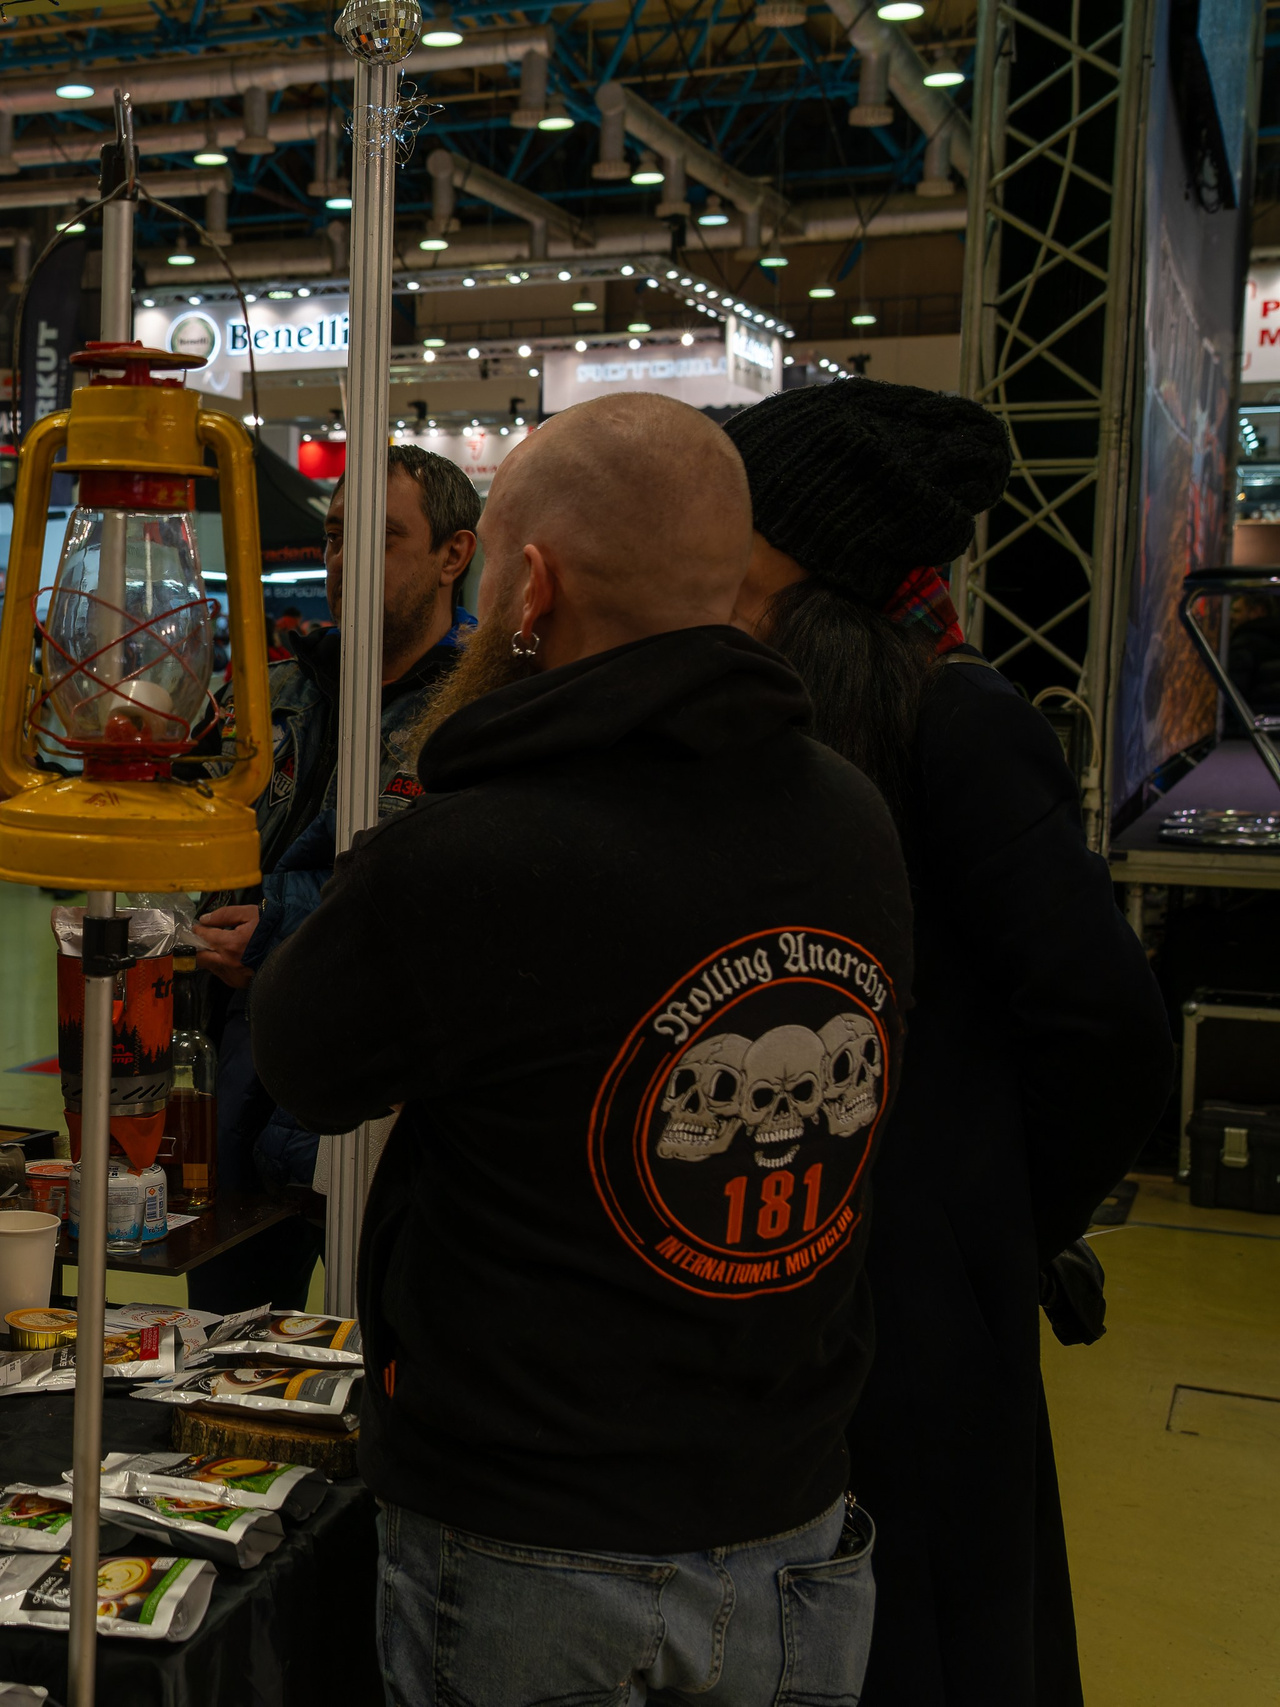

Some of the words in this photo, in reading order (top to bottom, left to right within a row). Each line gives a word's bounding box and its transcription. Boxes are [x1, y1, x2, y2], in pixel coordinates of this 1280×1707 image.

[230, 317, 349, 350] Benelli
[653, 946, 773, 1045] Rolling
[778, 932, 888, 1012] Anarchy
[724, 1163, 823, 1245] 181
[654, 1234, 781, 1284] INTERNATIONAL
[785, 1205, 855, 1277] MOTOCLUB
